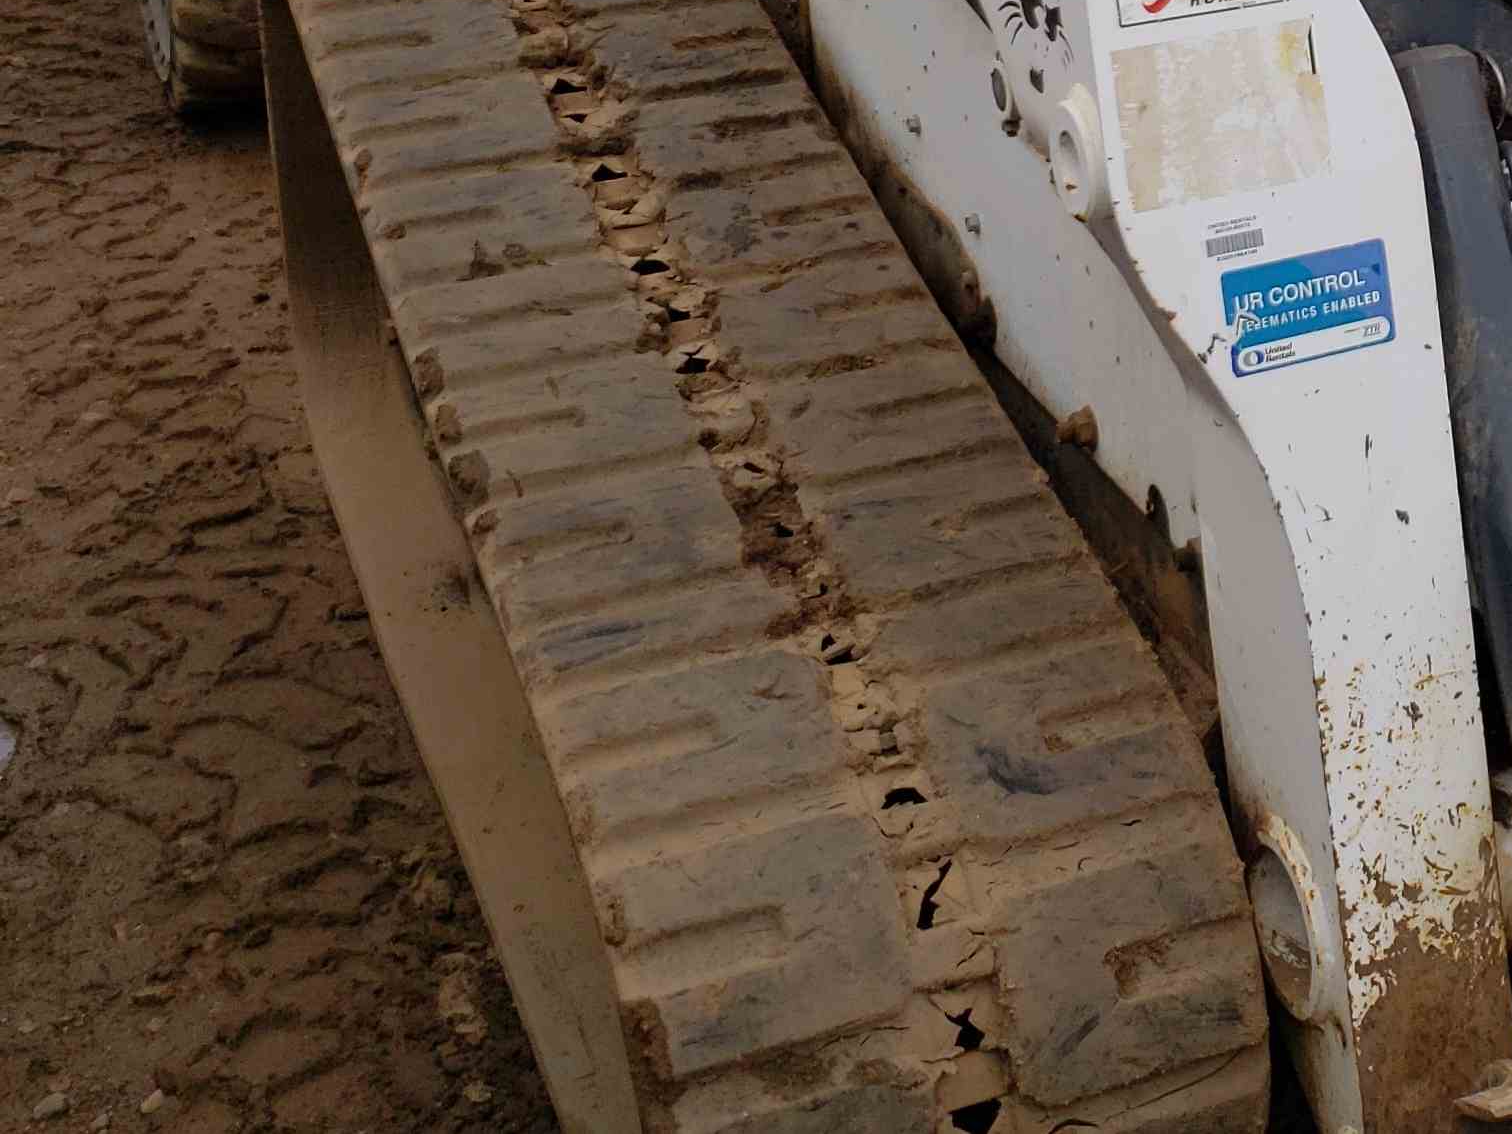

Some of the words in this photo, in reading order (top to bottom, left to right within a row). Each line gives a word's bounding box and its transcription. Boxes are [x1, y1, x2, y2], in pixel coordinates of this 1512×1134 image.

[1235, 291, 1265, 312] UR
[1269, 268, 1367, 306] CONTROL
[1322, 290, 1381, 315] ENABLED
